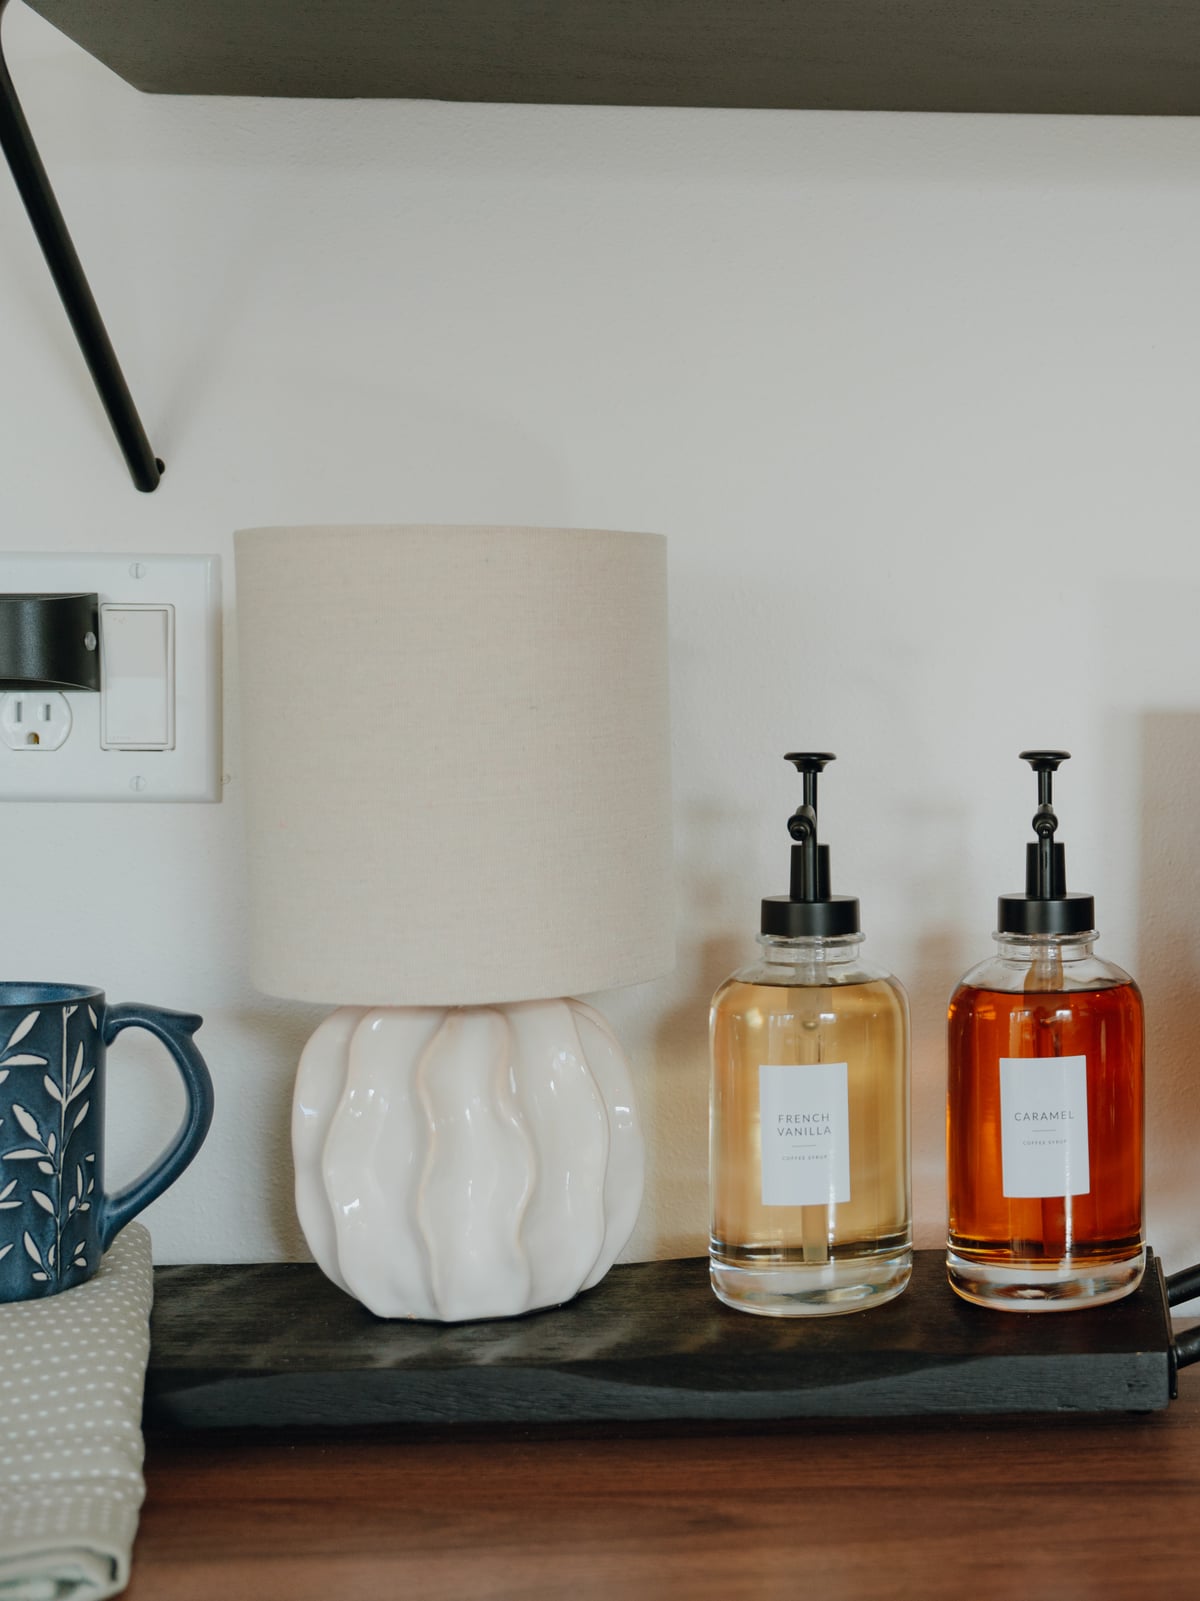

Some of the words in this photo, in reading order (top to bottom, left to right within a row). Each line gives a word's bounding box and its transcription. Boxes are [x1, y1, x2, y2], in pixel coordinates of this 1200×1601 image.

[778, 1112, 830, 1124] FRENCH
[1014, 1110, 1075, 1122] CARAMEL
[777, 1126, 832, 1137] VANILLA
